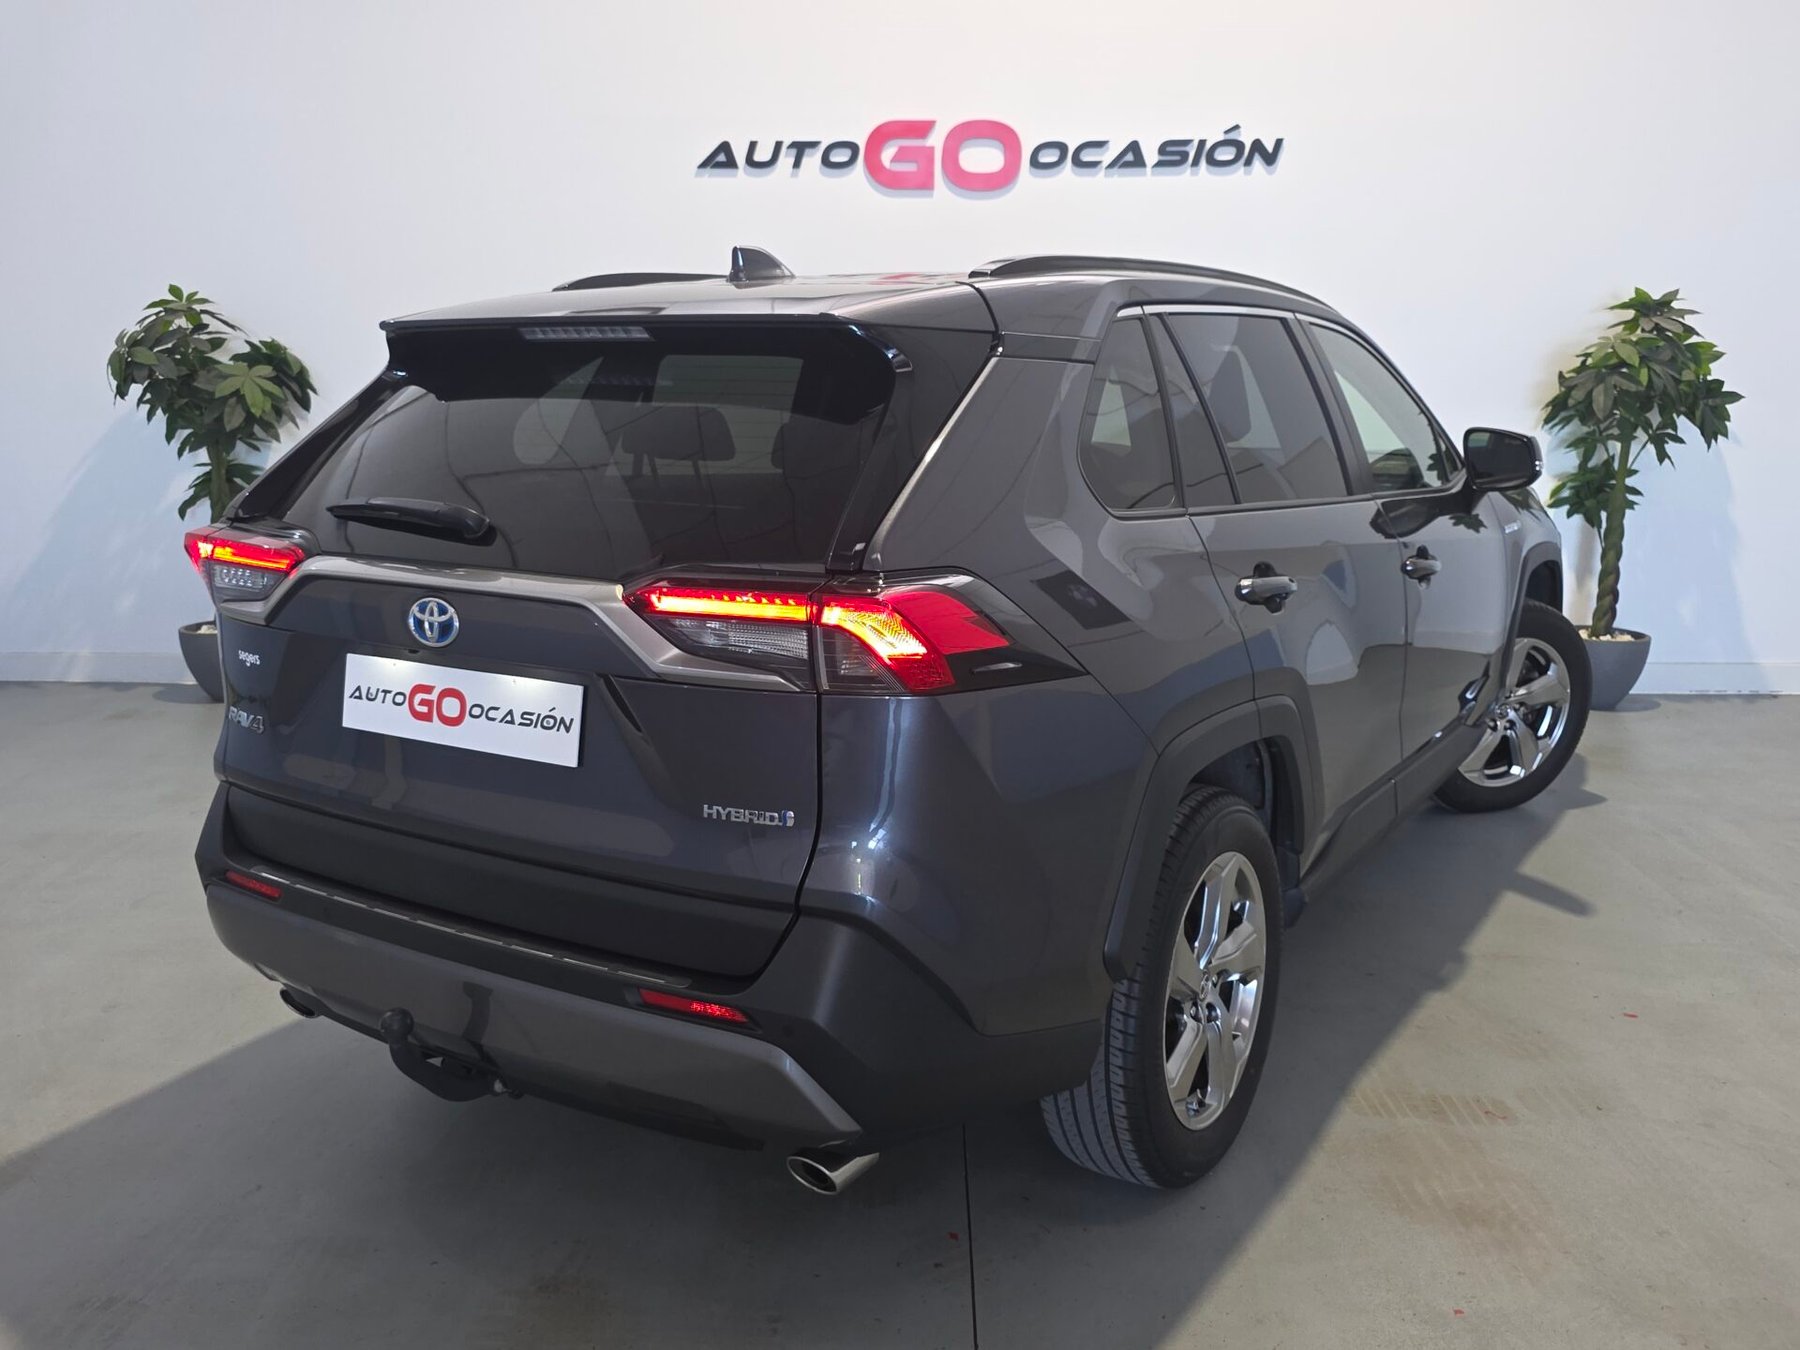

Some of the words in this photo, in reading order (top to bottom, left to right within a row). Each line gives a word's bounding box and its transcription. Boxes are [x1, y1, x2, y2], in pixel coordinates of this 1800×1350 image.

[697, 140, 861, 171] AUTO
[863, 119, 1023, 192] GO
[1029, 124, 1285, 171] OCASIÓN
[228, 705, 265, 733] RAV4
[349, 685, 408, 707] AUTO
[408, 683, 468, 728] GO
[468, 703, 575, 734] OCASIÓN
[703, 804, 780, 826] HYBRID
